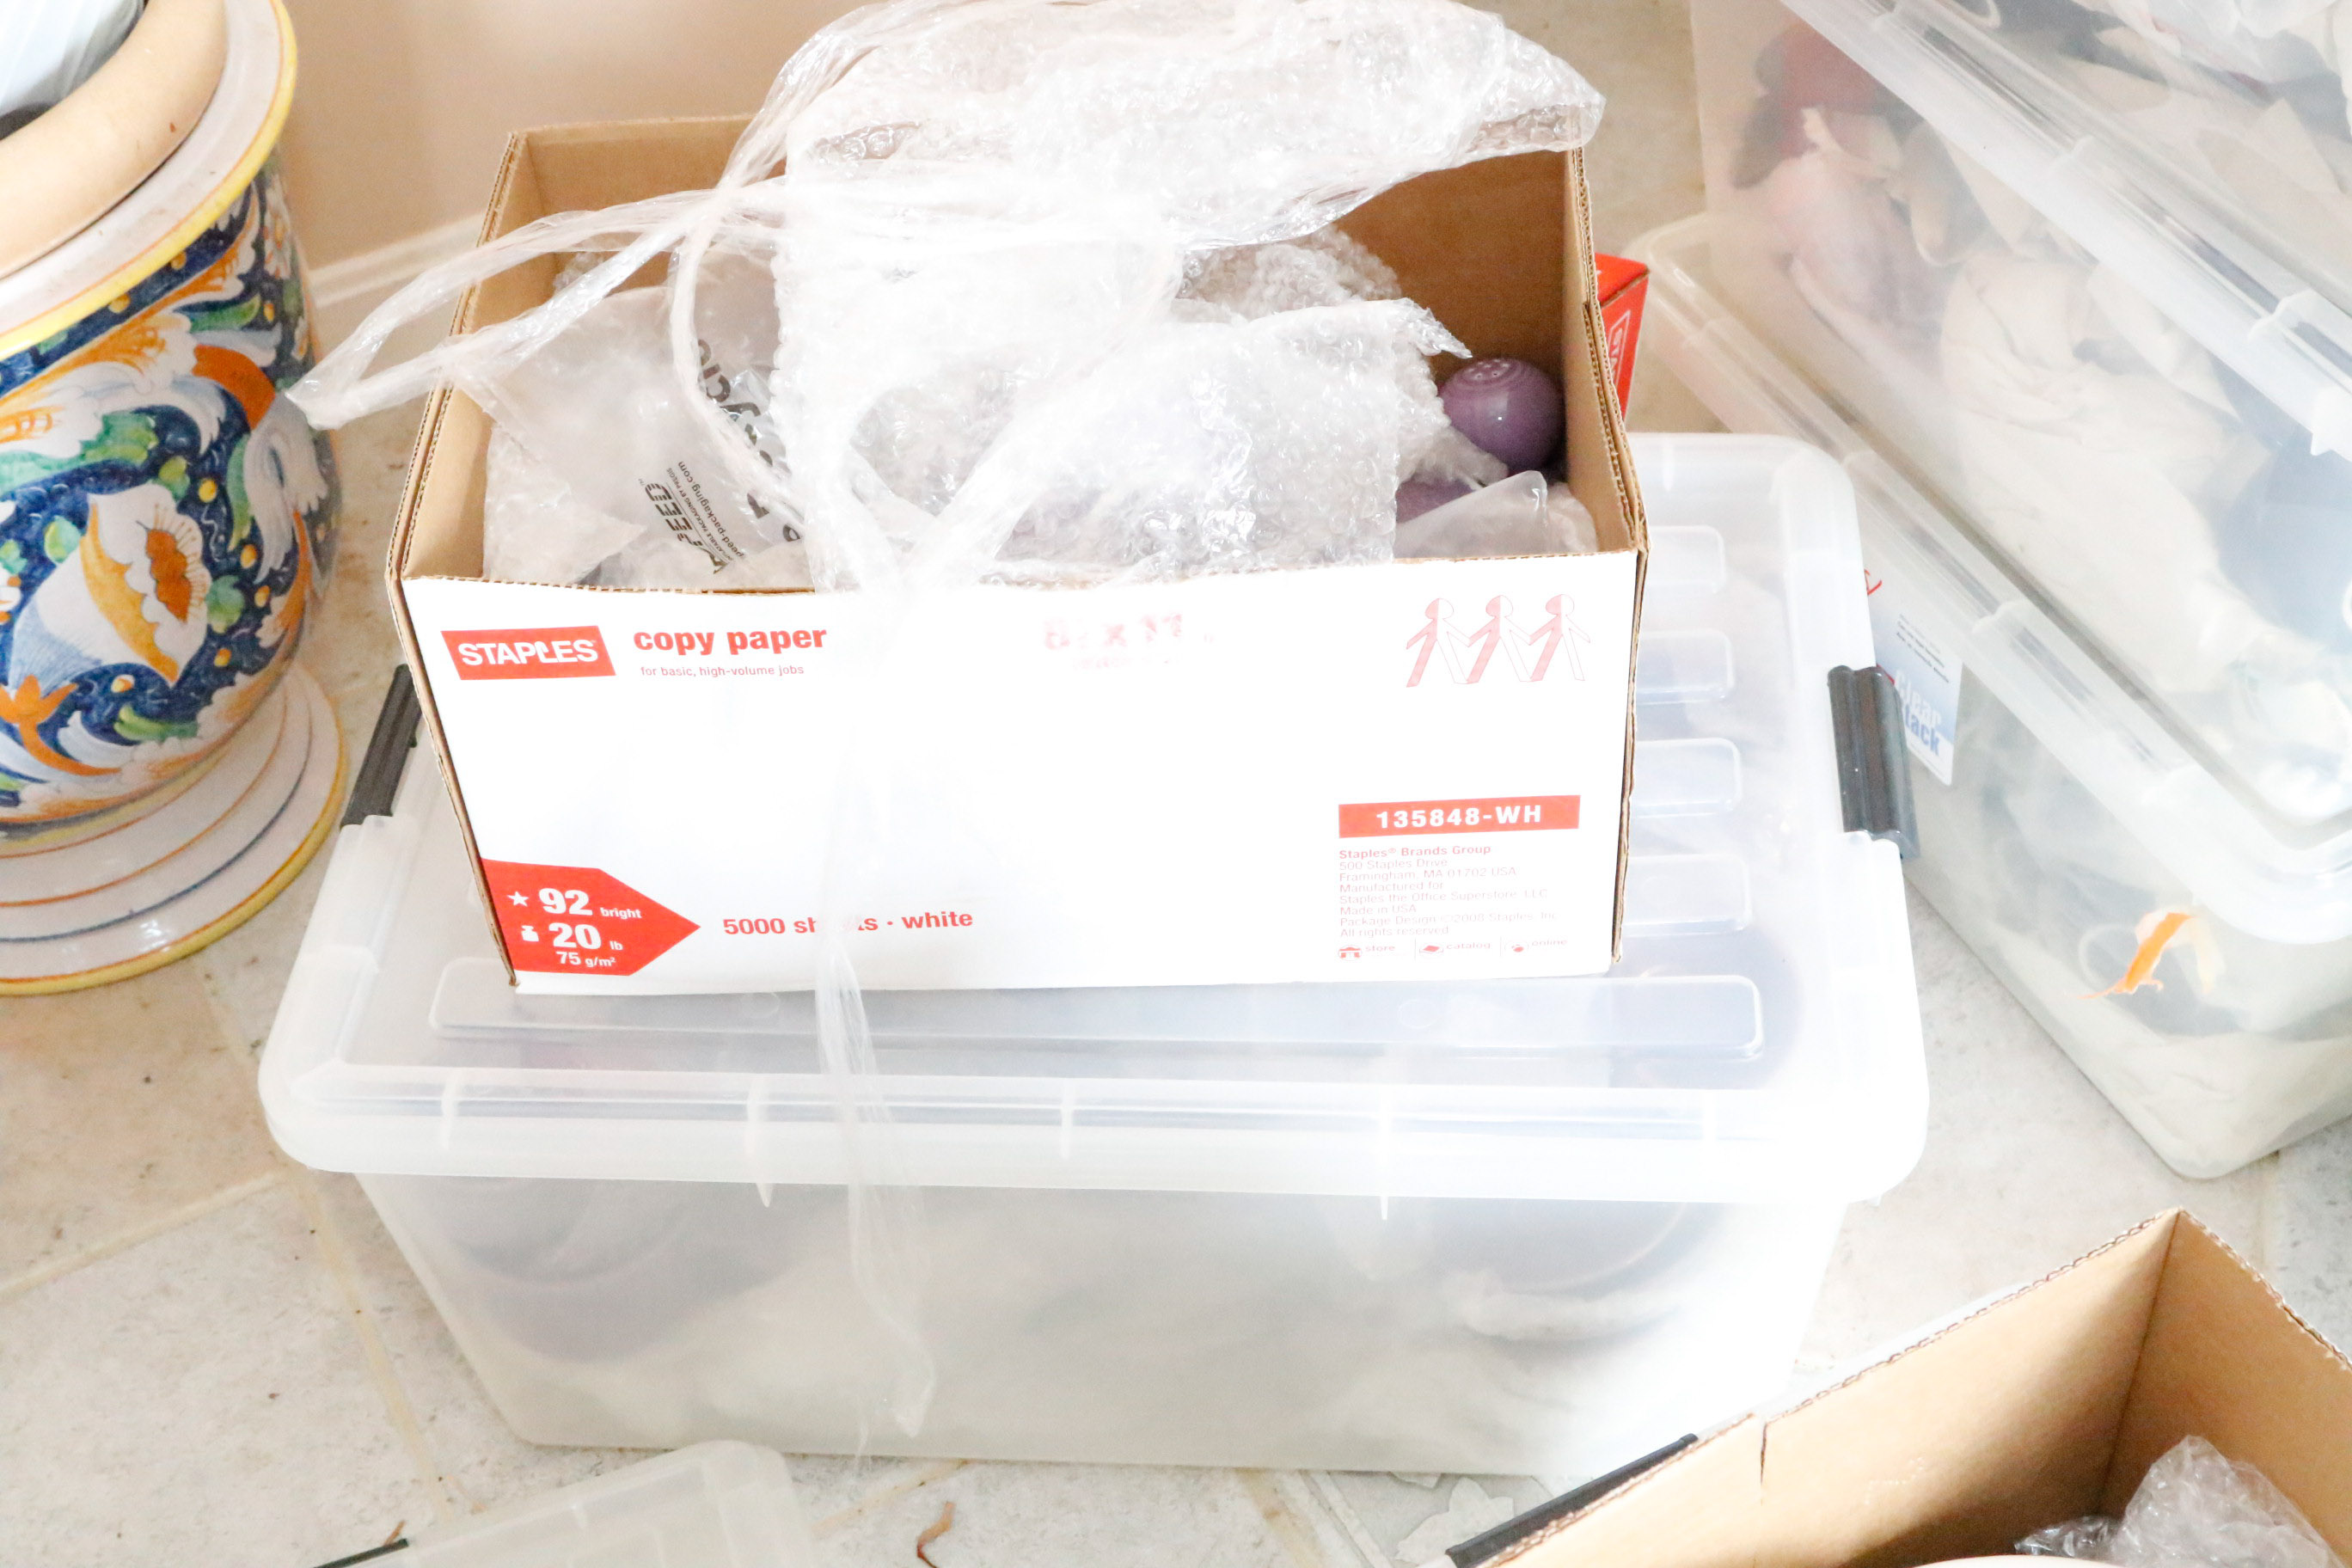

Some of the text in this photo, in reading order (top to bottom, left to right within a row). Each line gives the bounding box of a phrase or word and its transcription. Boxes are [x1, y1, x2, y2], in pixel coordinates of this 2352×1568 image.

[677, 461, 744, 560] peed-packaging.com
[683, 497, 709, 533] PACKAGING
[633, 625, 828, 656] copy paper
[458, 638, 599, 667] STAPLES
[640, 664, 805, 678] for basic, high-volume jobs
[1375, 805, 1541, 829] 135848-WH
[1401, 846, 1449, 856] Brands
[1451, 845, 1491, 855] Group
[1339, 858, 1449, 871] 500 Staples Drive
[1424, 869, 1443, 878] MA
[1448, 867, 1487, 878] 01702
[1491, 867, 1516, 876] USA
[1339, 881, 1444, 893] Manufactured for
[537, 887, 642, 921] 92 bright
[1340, 895, 1384, 905] Staples
[1388, 893, 1408, 903] the
[1412, 891, 1447, 902] Office
[1340, 903, 1418, 916] Made in USA
[724, 916, 786, 936] 5000
[901, 910, 974, 930] white
[1340, 916, 1392, 928] Package
[1395, 915, 1436, 926] Design
[548, 922, 623, 951] 20 lb
[1340, 928, 1356, 938] All
[1358, 927, 1393, 939] rights
[1445, 942, 1492, 951] catalog
[555, 950, 582, 966] 75
